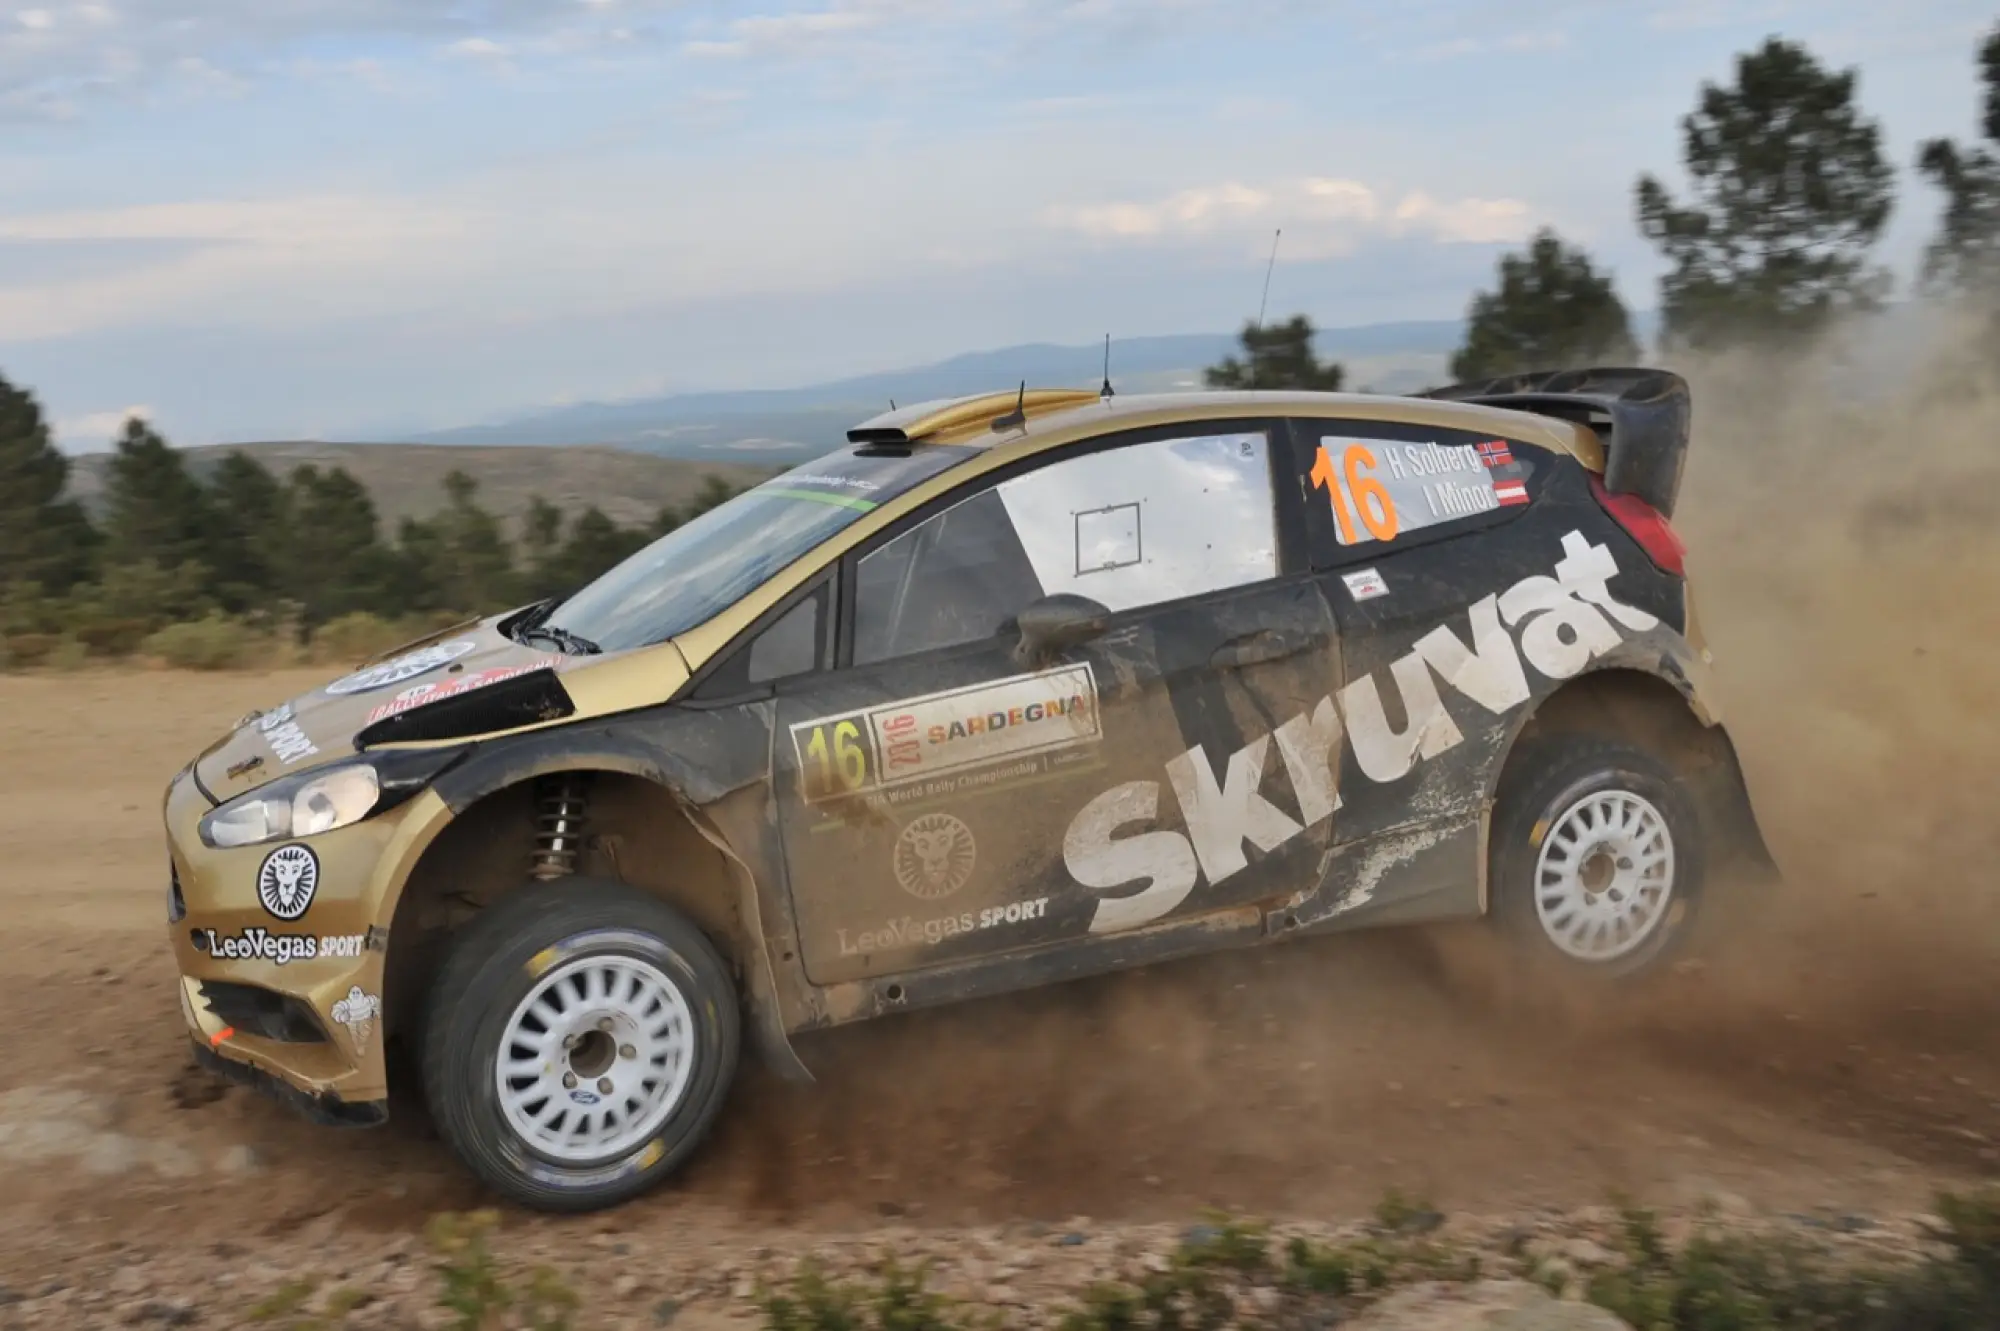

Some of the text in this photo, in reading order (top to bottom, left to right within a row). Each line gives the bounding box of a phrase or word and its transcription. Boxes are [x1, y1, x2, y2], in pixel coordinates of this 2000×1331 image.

[1384, 441, 1482, 479] H Solberg
[1310, 443, 1399, 545] 16
[1423, 481, 1494, 517] I Minor
[882, 714, 922, 770] 2016
[927, 694, 1085, 745] SARDEGNA
[807, 720, 865, 794] 16
[889, 785, 924, 803] World
[926, 780, 956, 796] Rally
[957, 761, 1038, 789] Championship
[207, 928, 365, 964] LeoVegas SPORT
[836, 897, 1049, 956] LeoVegas SPORT
